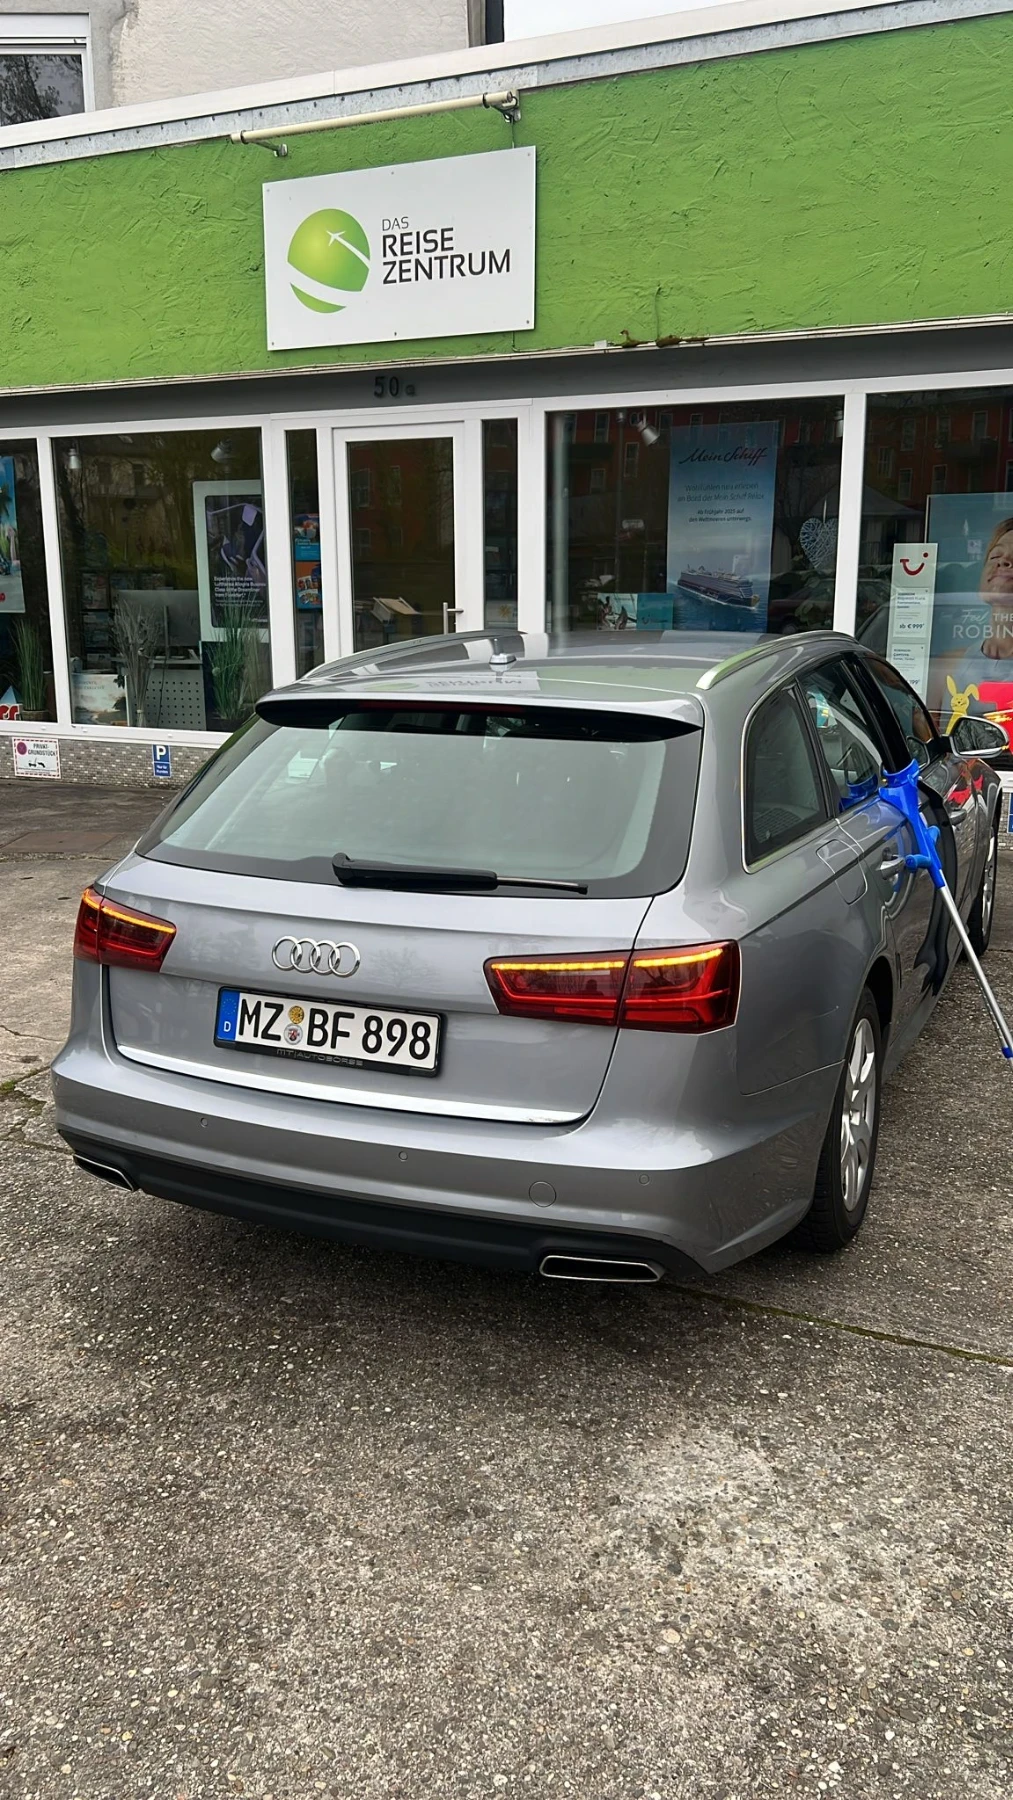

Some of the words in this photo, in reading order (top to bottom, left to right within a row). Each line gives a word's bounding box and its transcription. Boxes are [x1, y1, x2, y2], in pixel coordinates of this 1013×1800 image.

[382, 216, 409, 231] DAS
[382, 227, 454, 258] REISE
[382, 249, 511, 285] ZENTRUM
[679, 448, 722, 465] Mein
[723, 446, 768, 466] Schiff
[156, 746, 167, 760] P
[223, 1021, 231, 1032] D
[238, 998, 284, 1041] MZ
[307, 1007, 355, 1049] BF
[361, 1015, 432, 1060] 898
